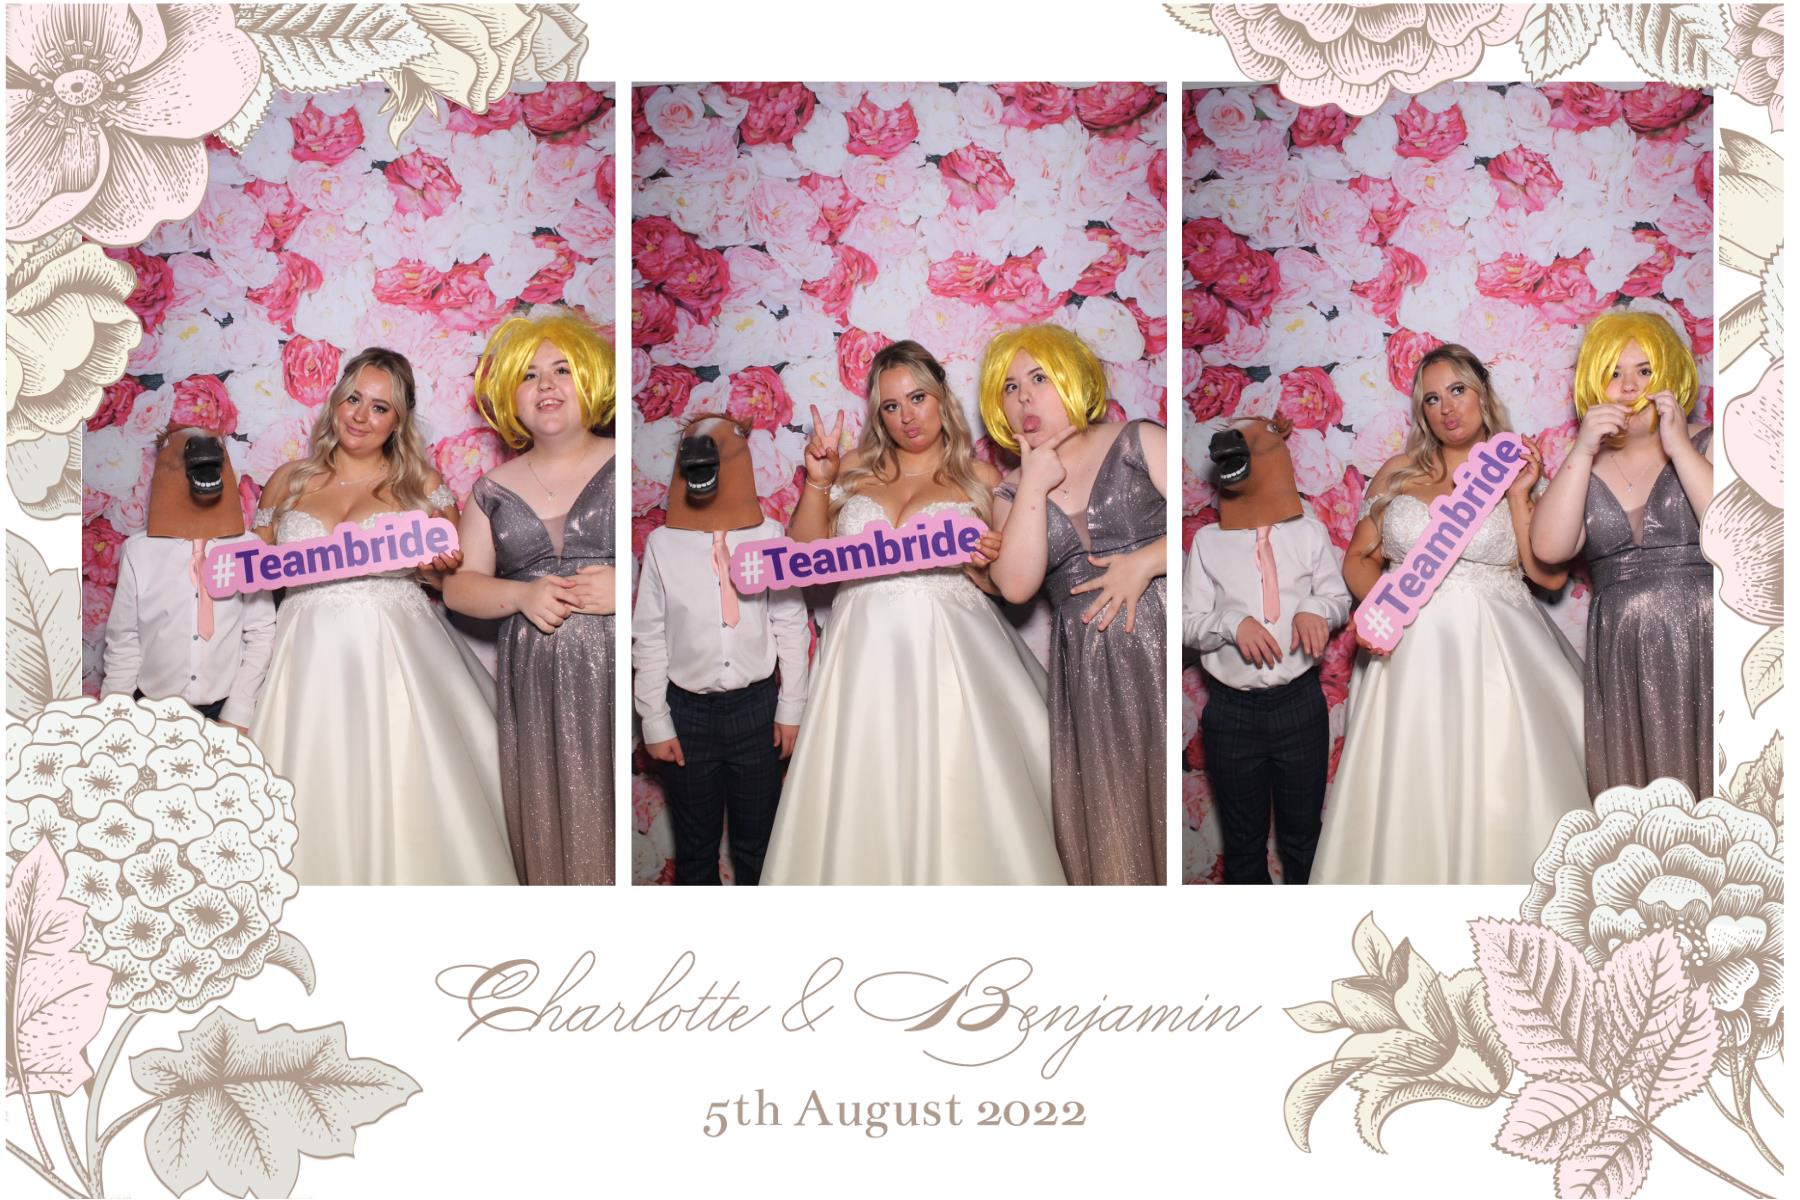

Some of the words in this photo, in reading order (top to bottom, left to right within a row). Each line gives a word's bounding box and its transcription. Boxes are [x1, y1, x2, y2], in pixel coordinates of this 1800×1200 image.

[212, 519, 449, 588] #Teambride
[740, 519, 980, 585] #Teambride
[1364, 440, 1522, 640] #Teambride
